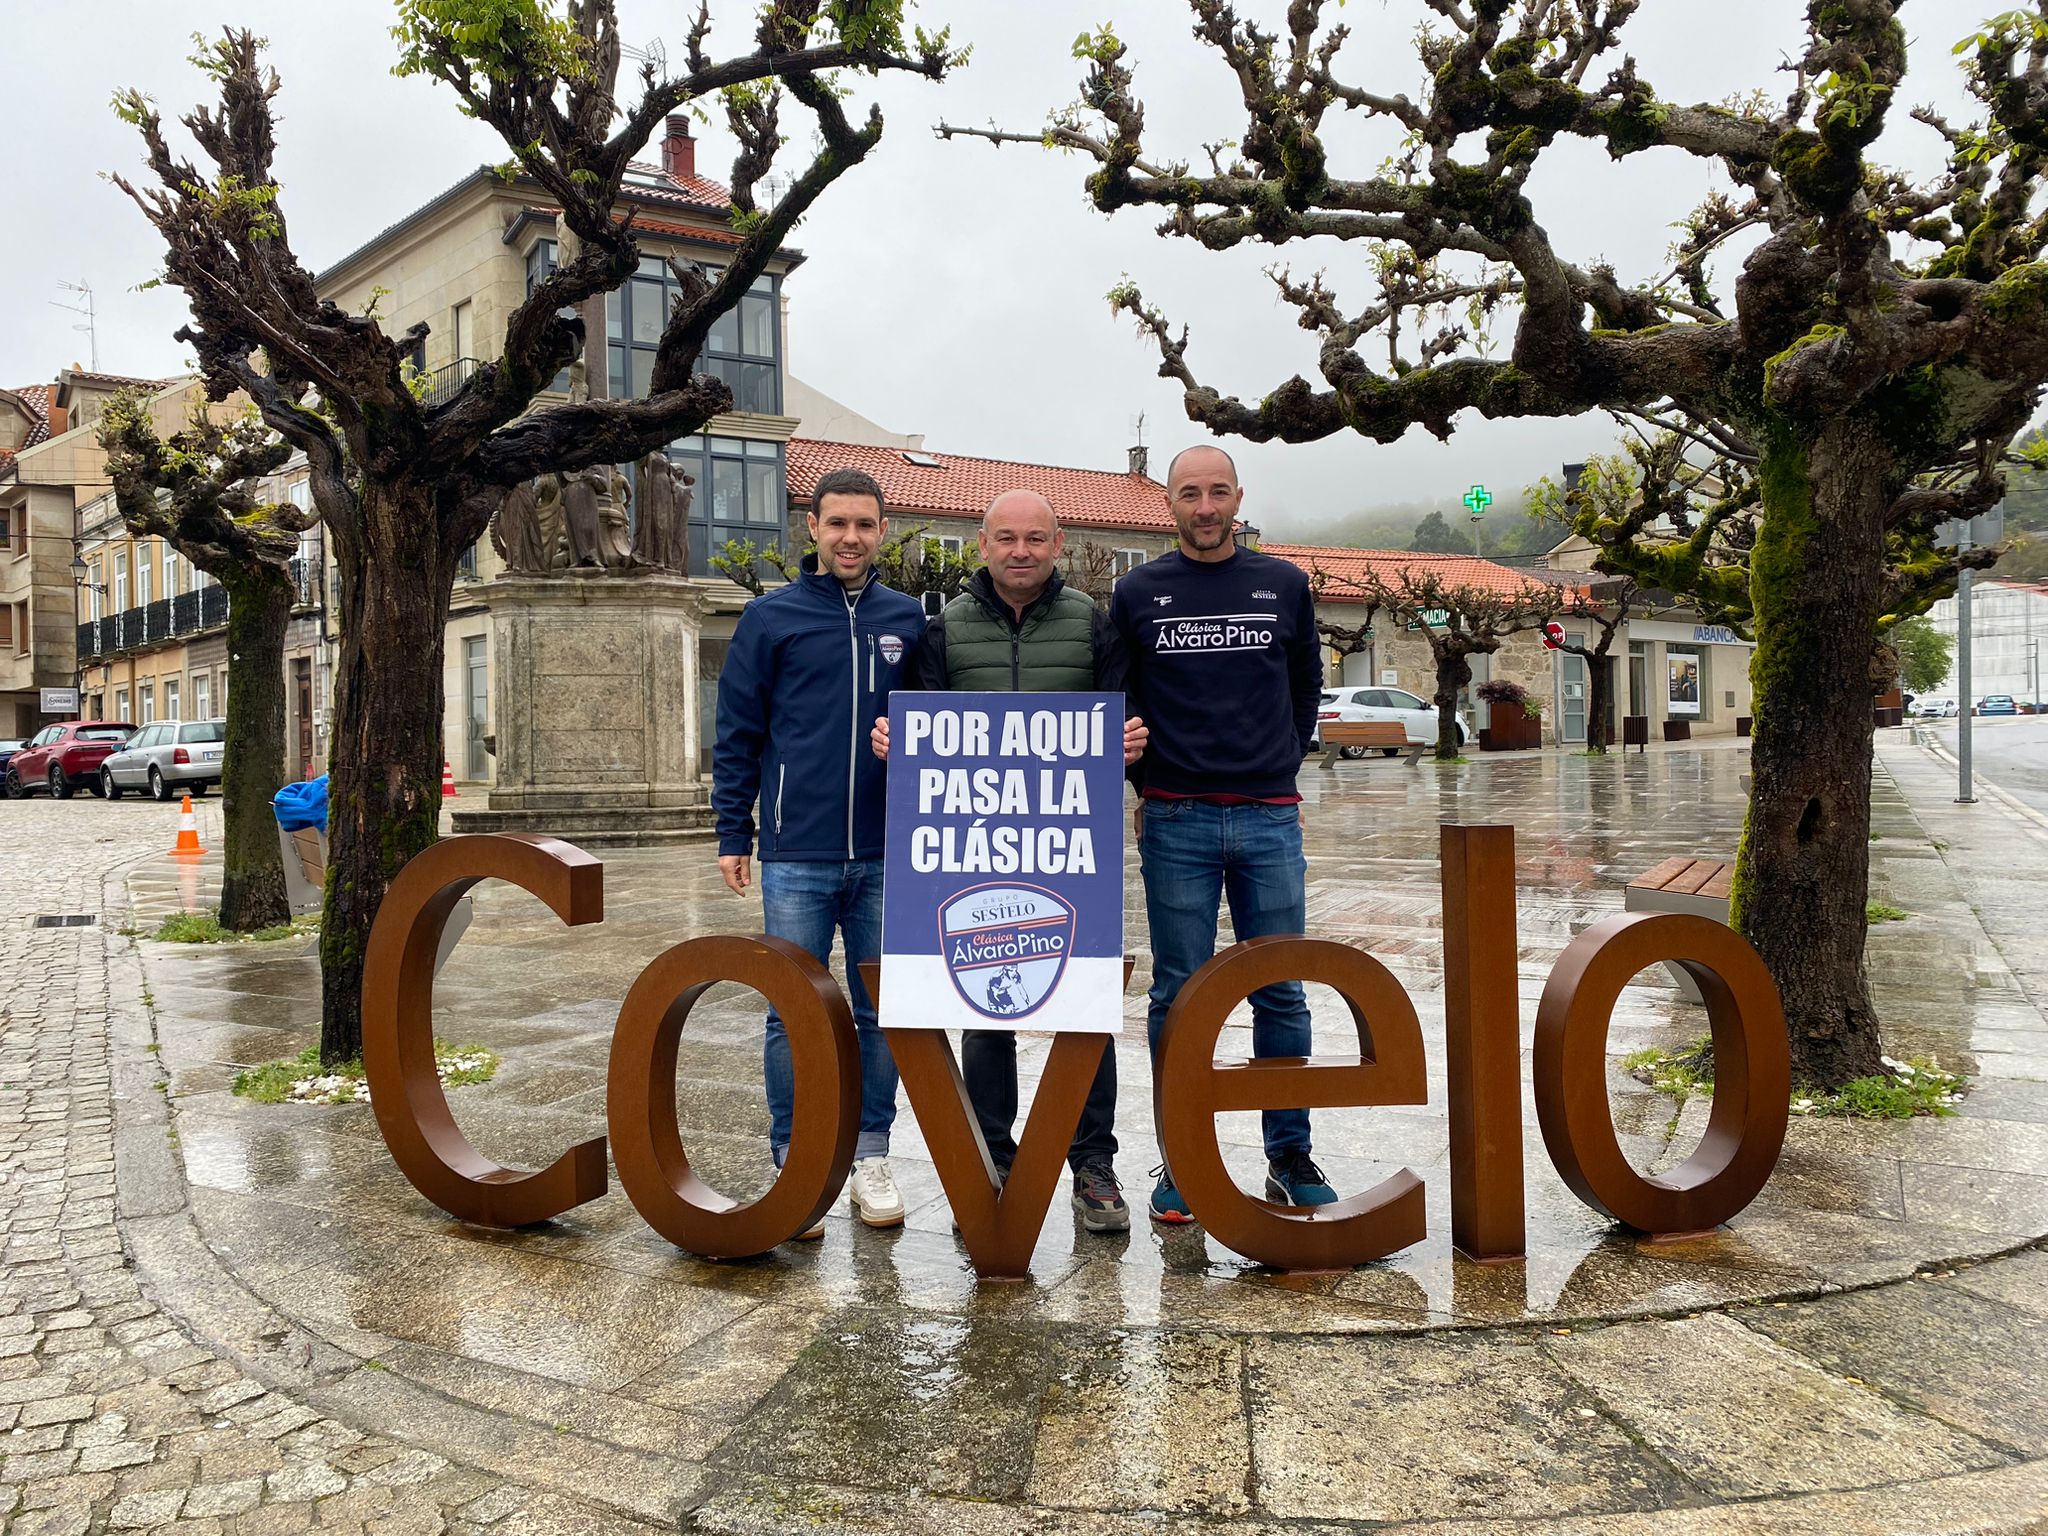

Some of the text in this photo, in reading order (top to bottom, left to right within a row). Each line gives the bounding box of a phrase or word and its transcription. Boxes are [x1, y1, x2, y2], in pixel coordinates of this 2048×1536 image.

[1178, 622, 1222, 634] Clásica
[1409, 609, 1447, 625] MACIA
[905, 702, 1107, 761] POR AQUÍ
[919, 768, 1090, 815] PASA LA
[911, 818, 1096, 874] CLÁSICA
[982, 894, 1019, 905] GRUPO
[972, 933, 1014, 946] Clásica
[362, 824, 1790, 1281] Covelo
